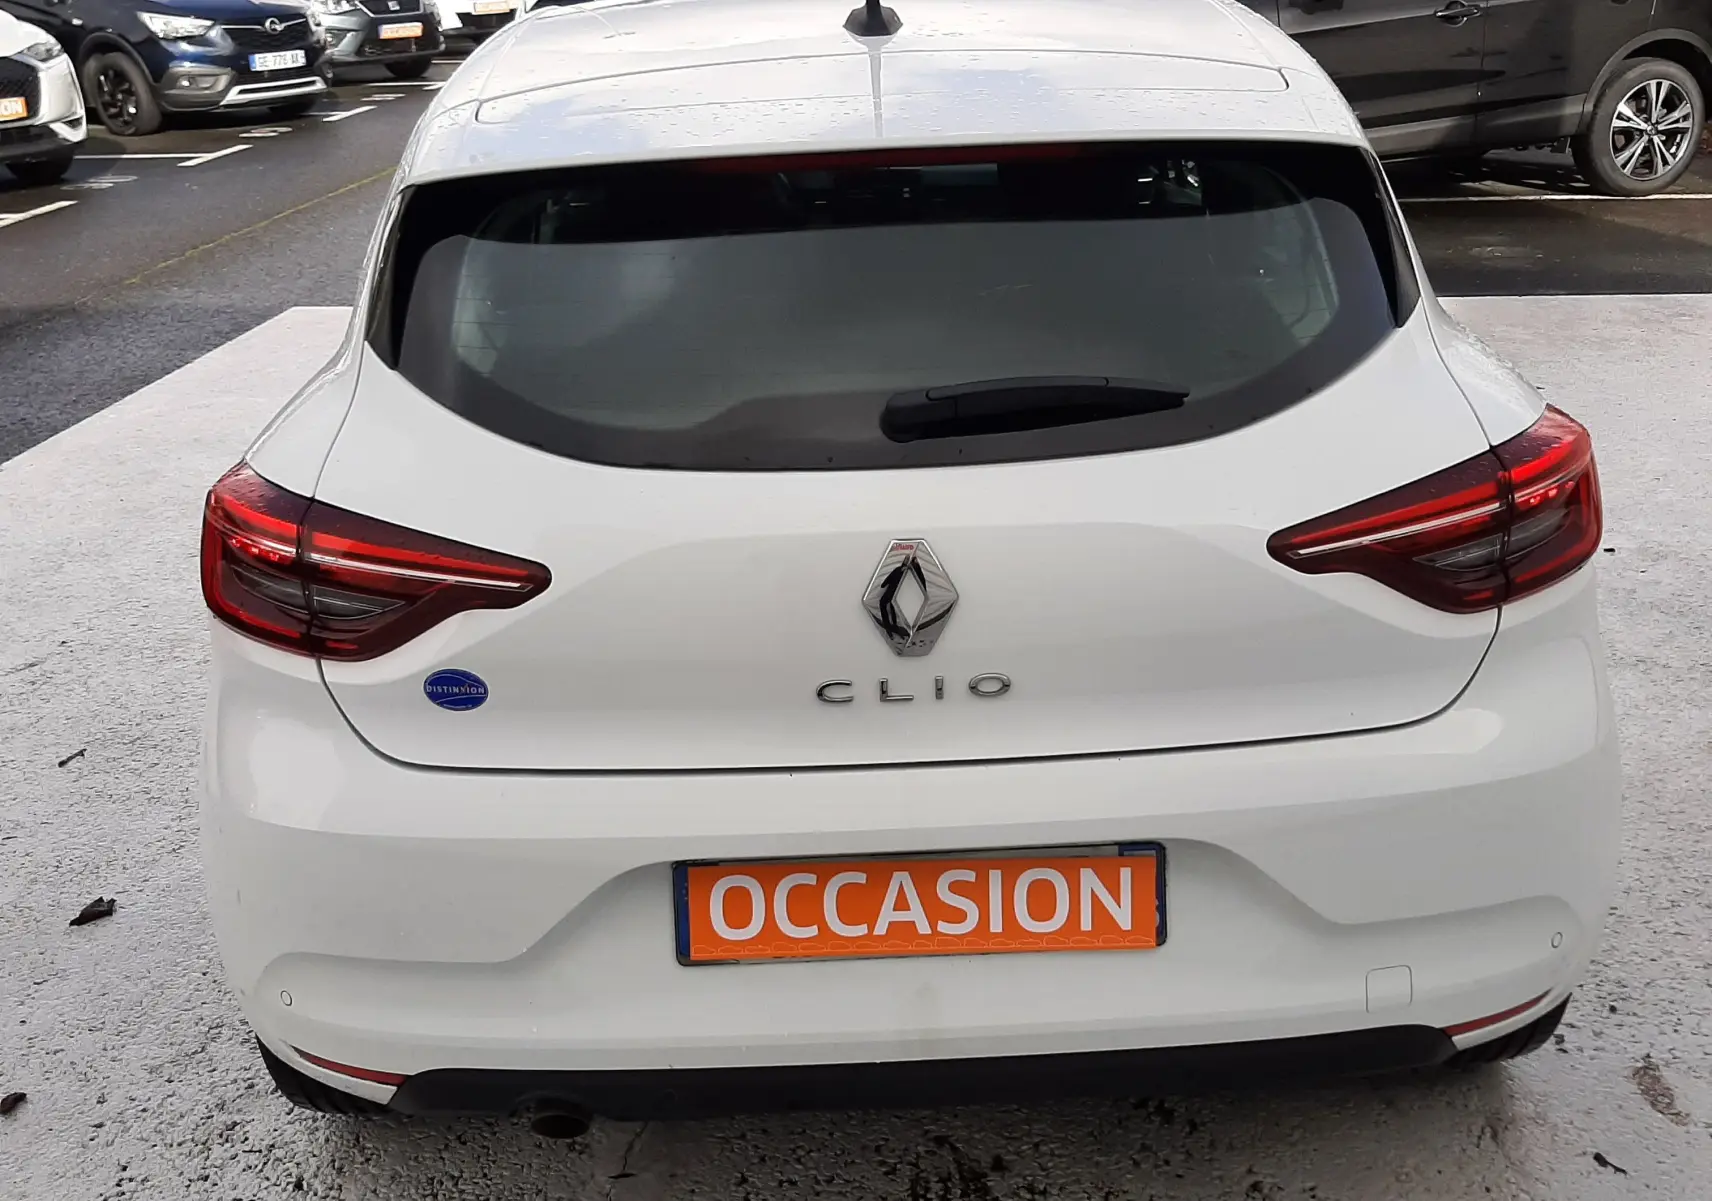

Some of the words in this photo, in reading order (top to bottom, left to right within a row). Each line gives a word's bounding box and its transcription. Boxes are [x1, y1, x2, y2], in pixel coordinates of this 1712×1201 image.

[426, 684, 485, 695] DISTINXION
[816, 673, 1011, 703] CLIO
[709, 867, 1132, 940] OCCASION
